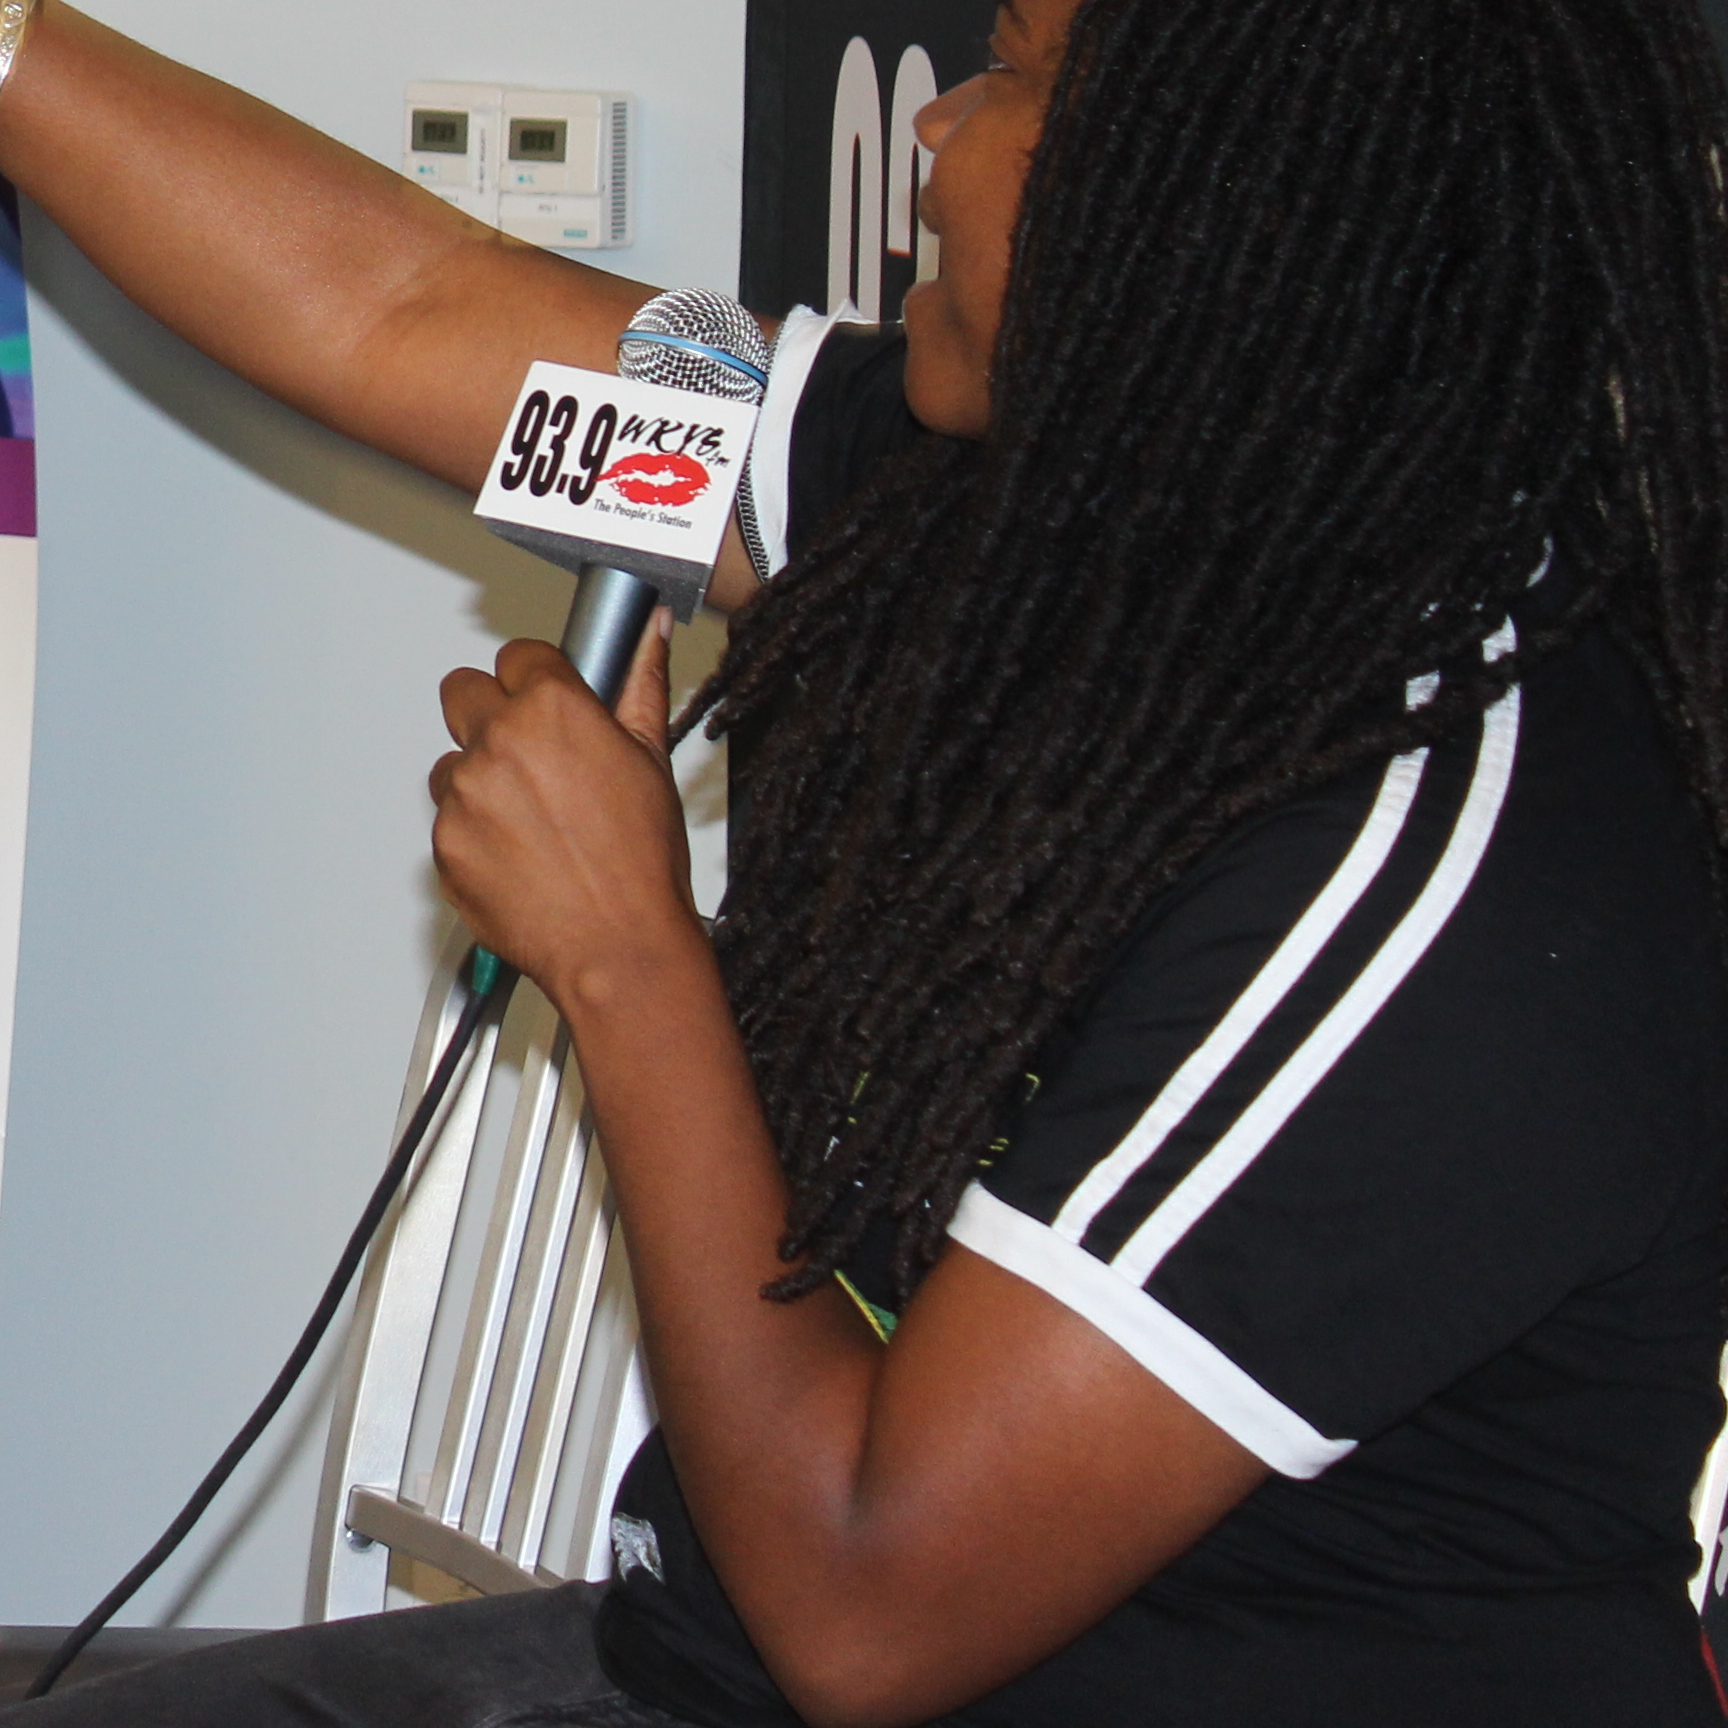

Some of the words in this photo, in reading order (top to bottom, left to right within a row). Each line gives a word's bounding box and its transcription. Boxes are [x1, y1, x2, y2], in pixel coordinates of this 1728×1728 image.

[499, 388, 618, 506] 93.9
[617, 413, 726, 458] WKYS
[593, 498, 612, 513] The
[613, 502, 656, 521] People's
[656, 511, 693, 530] Station
